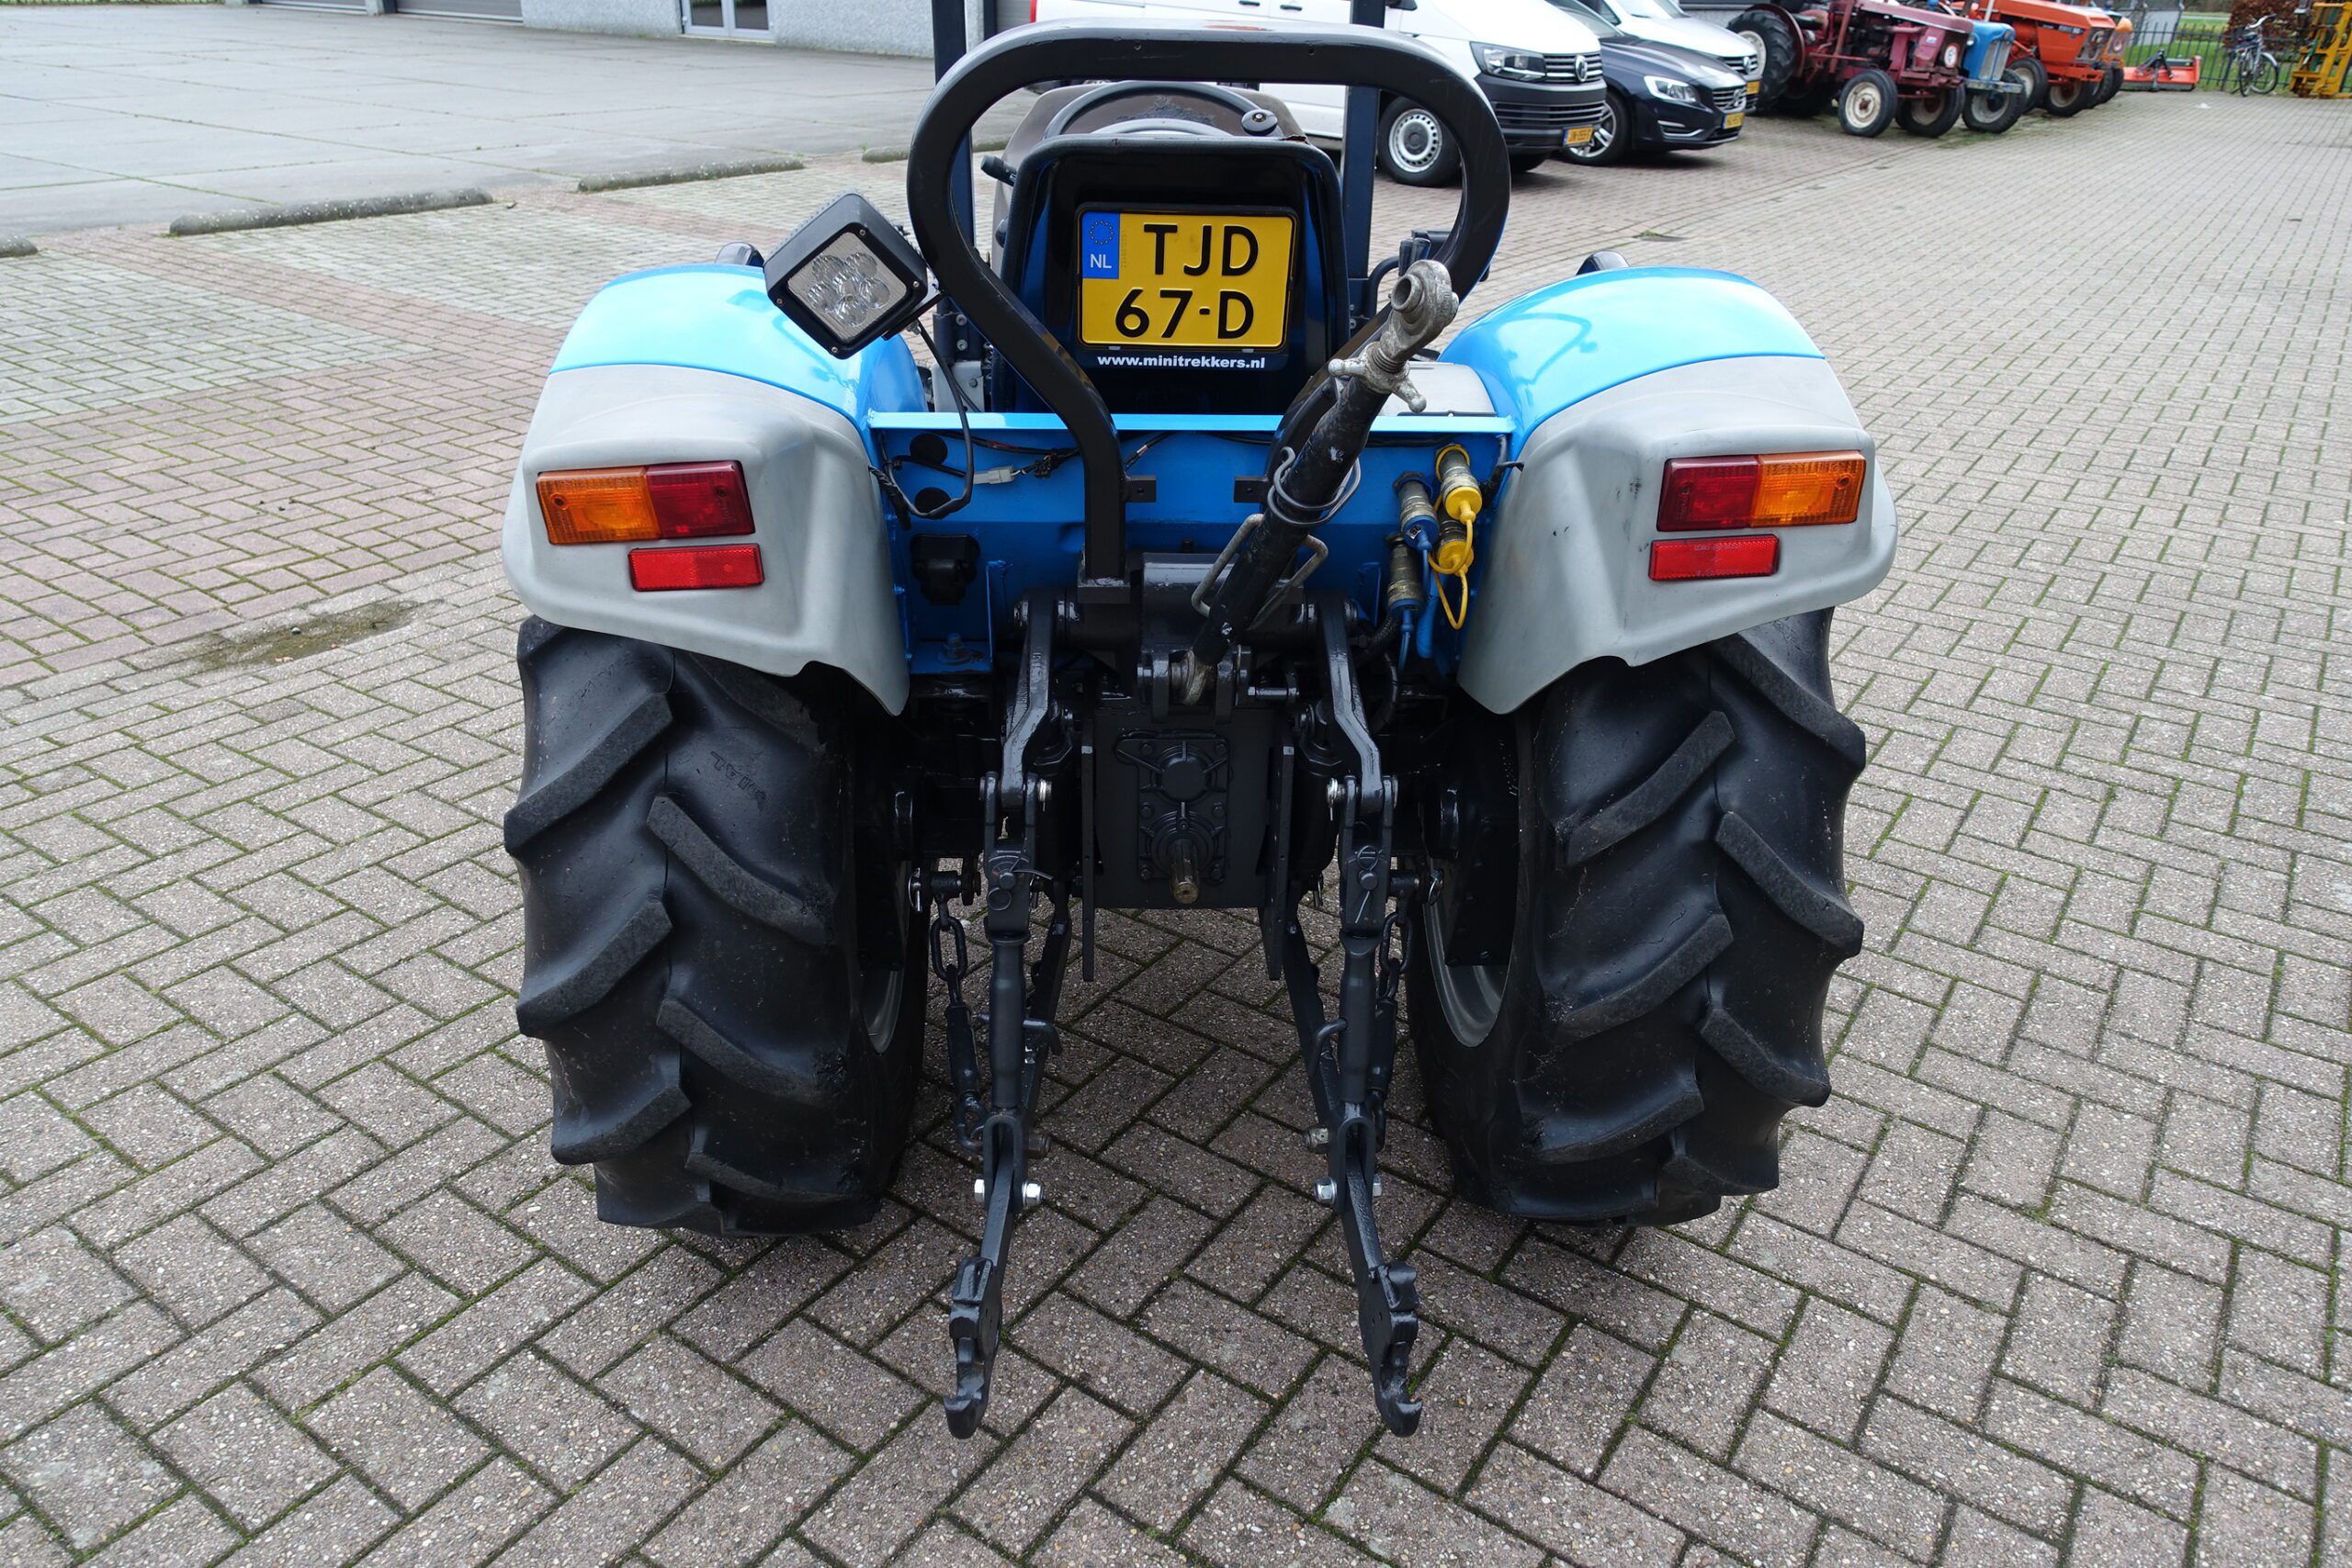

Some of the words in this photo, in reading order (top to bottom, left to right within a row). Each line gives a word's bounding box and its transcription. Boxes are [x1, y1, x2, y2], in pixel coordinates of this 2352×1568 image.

[1090, 254, 1112, 269] NL
[1143, 222, 1259, 276] TJD
[1114, 287, 1254, 339] 67-D
[1097, 355, 1266, 369] www.minitrekkers.nl
